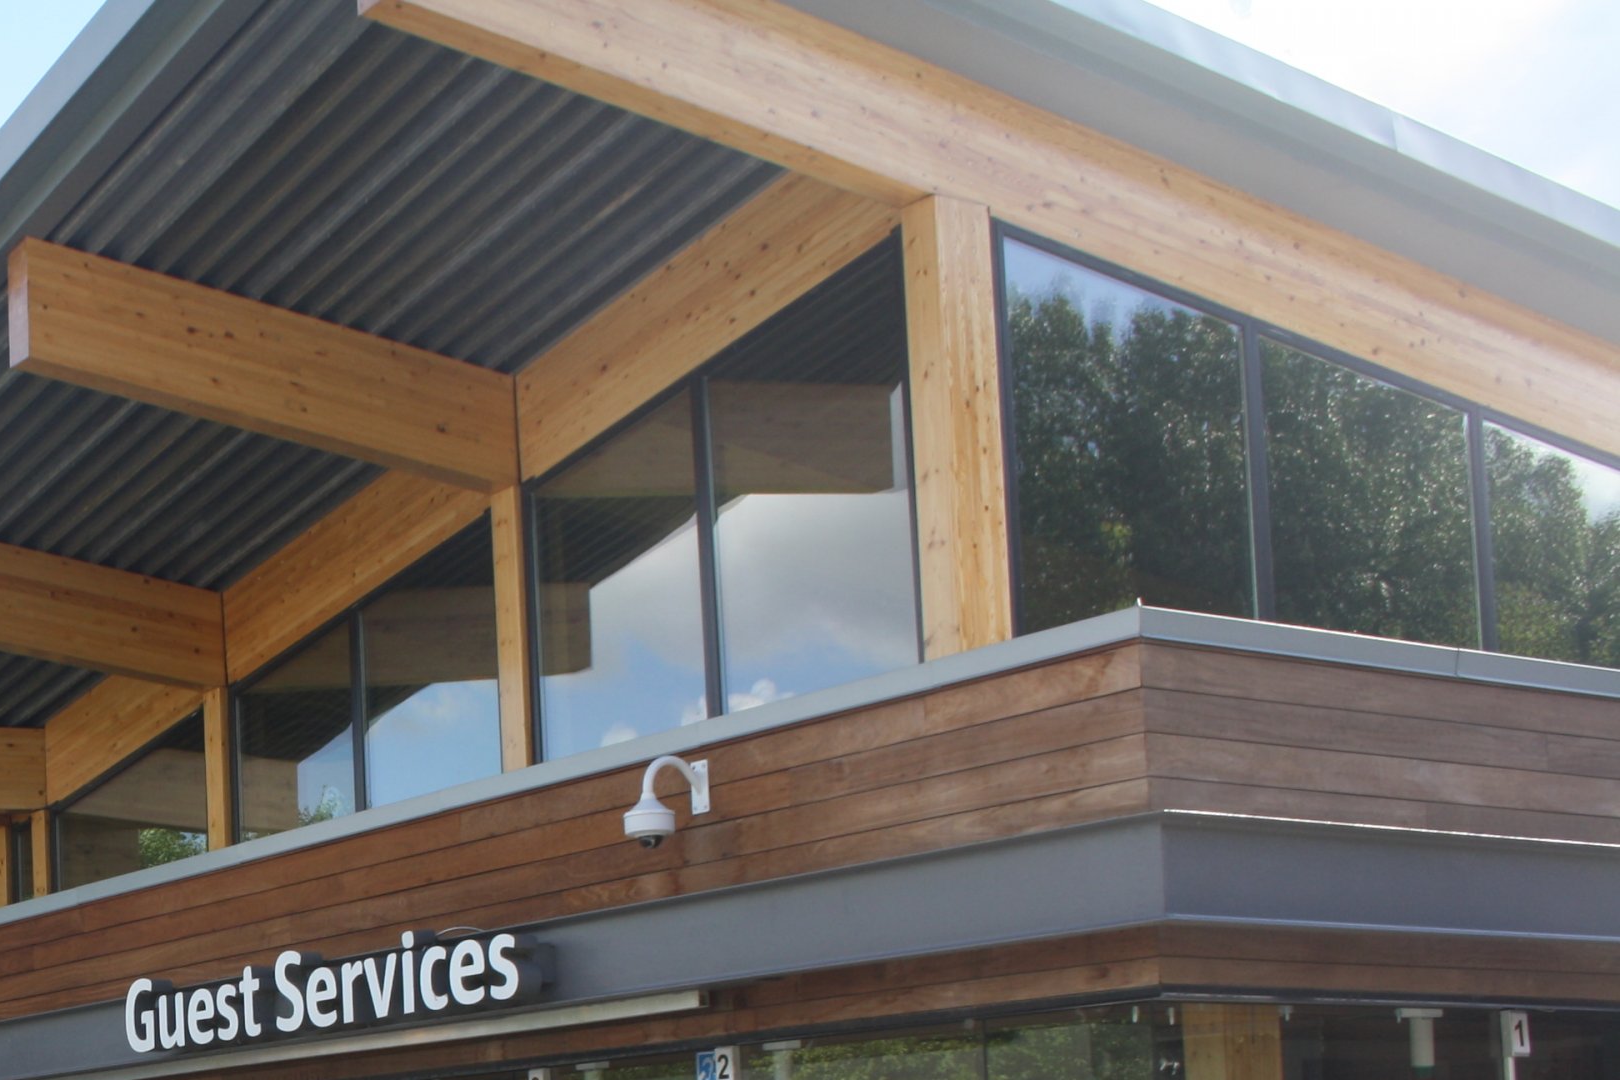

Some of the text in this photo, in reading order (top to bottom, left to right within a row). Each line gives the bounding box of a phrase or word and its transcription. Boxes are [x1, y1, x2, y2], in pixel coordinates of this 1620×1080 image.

[125, 930, 520, 1053] Guest Services
[1515, 1020, 1525, 1047] 1
[717, 1055, 730, 1080] 2
